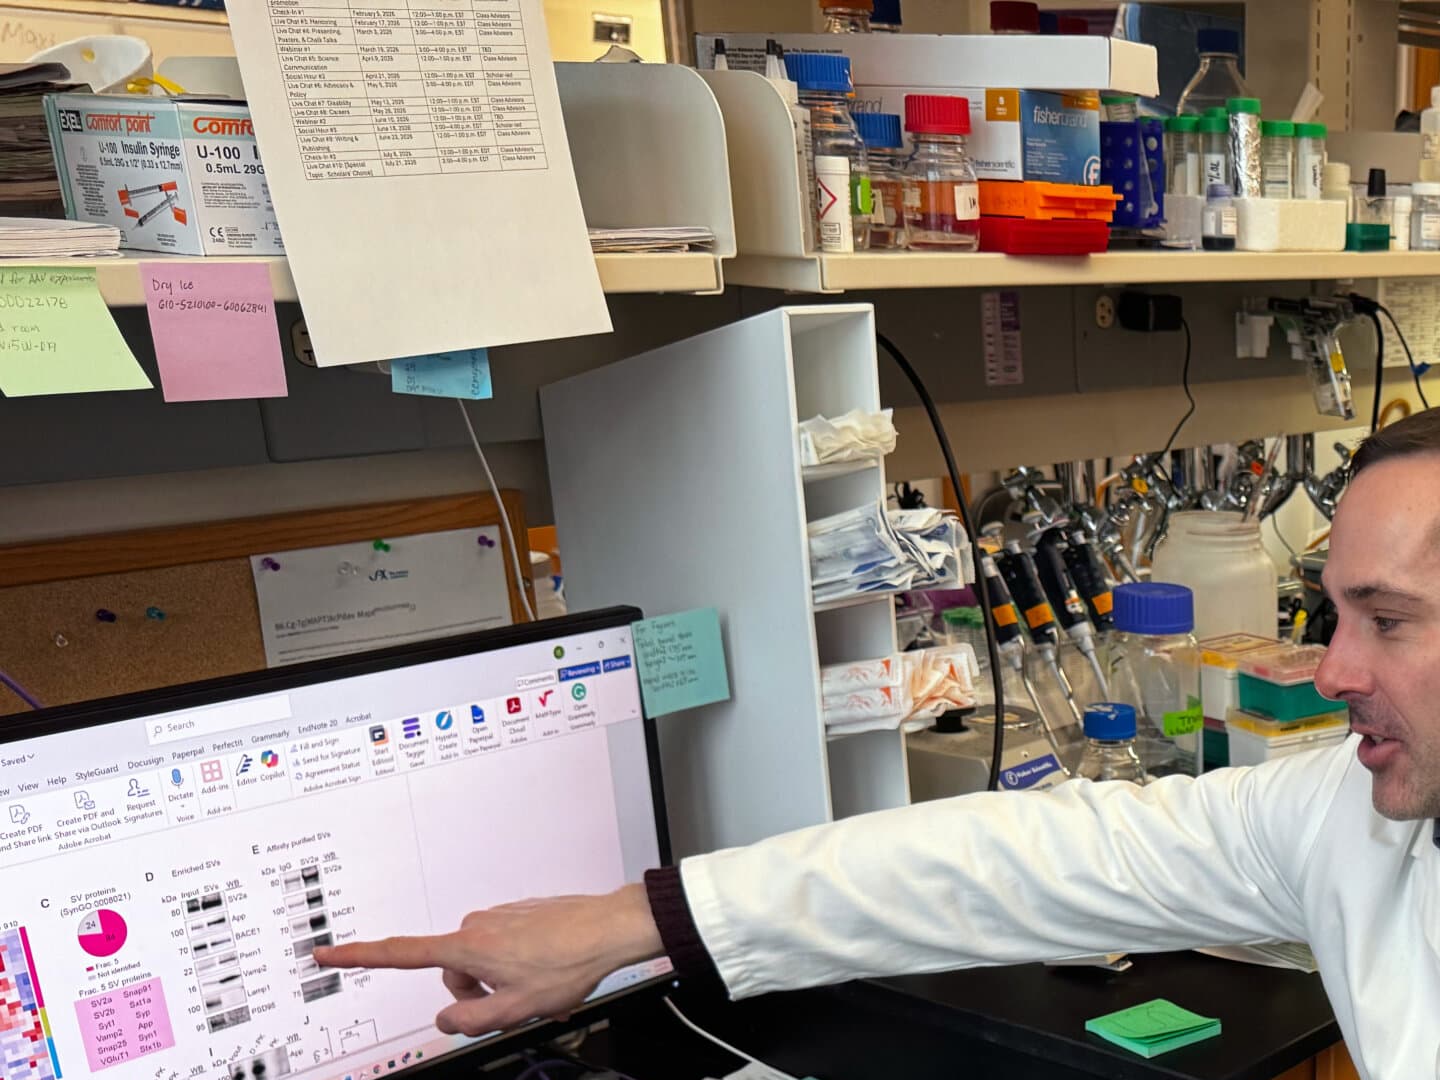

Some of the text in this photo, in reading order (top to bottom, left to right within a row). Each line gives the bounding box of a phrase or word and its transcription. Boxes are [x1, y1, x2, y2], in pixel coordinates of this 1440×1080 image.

[61, 111, 155, 136] EXEL Comfort point
[99, 142, 180, 159] U-100 Insulin Syringe
[197, 145, 241, 160] U-100
[206, 163, 264, 175] 0.5mL 29G
[152, 279, 173, 295] Dry
[167, 720, 195, 732] Search
[18, 781, 39, 792] View
[47, 776, 67, 787] Help
[75, 765, 119, 780] StyleGuard
[128, 755, 164, 769] Docusign
[172, 747, 205, 760] Paperpal
[252, 730, 290, 744] Grammarly
[298, 722, 327, 734] EndNote
[329, 720, 338, 728] 20
[346, 713, 372, 723] Acrobat
[1, 756, 26, 767] Saved
[237, 771, 285, 787] Editor Copilot
[201, 783, 229, 795] Add-ins
[168, 791, 193, 802] Dictate
[127, 800, 156, 812] Request
[207, 805, 232, 816] Add-ins
[57, 809, 115, 827] Create PDF and
[124, 809, 162, 824] Signatures
[177, 814, 194, 823] Voice
[0, 824, 43, 840] Create PDF
[54, 818, 121, 839] Share via Outlook
[14, 834, 51, 849] Share link
[58, 833, 111, 851] Adobe Acrobat
[252, 845, 259, 855] E
[172, 863, 204, 877] Enriched
[145, 872, 154, 882] D
[71, 887, 116, 903] SV proteins
[162, 895, 177, 903] kDa
[41, 899, 49, 908] C
[86, 921, 95, 929] 24
[171, 929, 184, 938] 100
[98, 970, 110, 978] Not
[109, 980, 119, 989] SV
[91, 984, 151, 1008] SV2a Snap91
[94, 1008, 115, 1019] SV2b
[96, 1021, 153, 1042] Vamp2 App
[98, 1040, 127, 1054] Snap25
